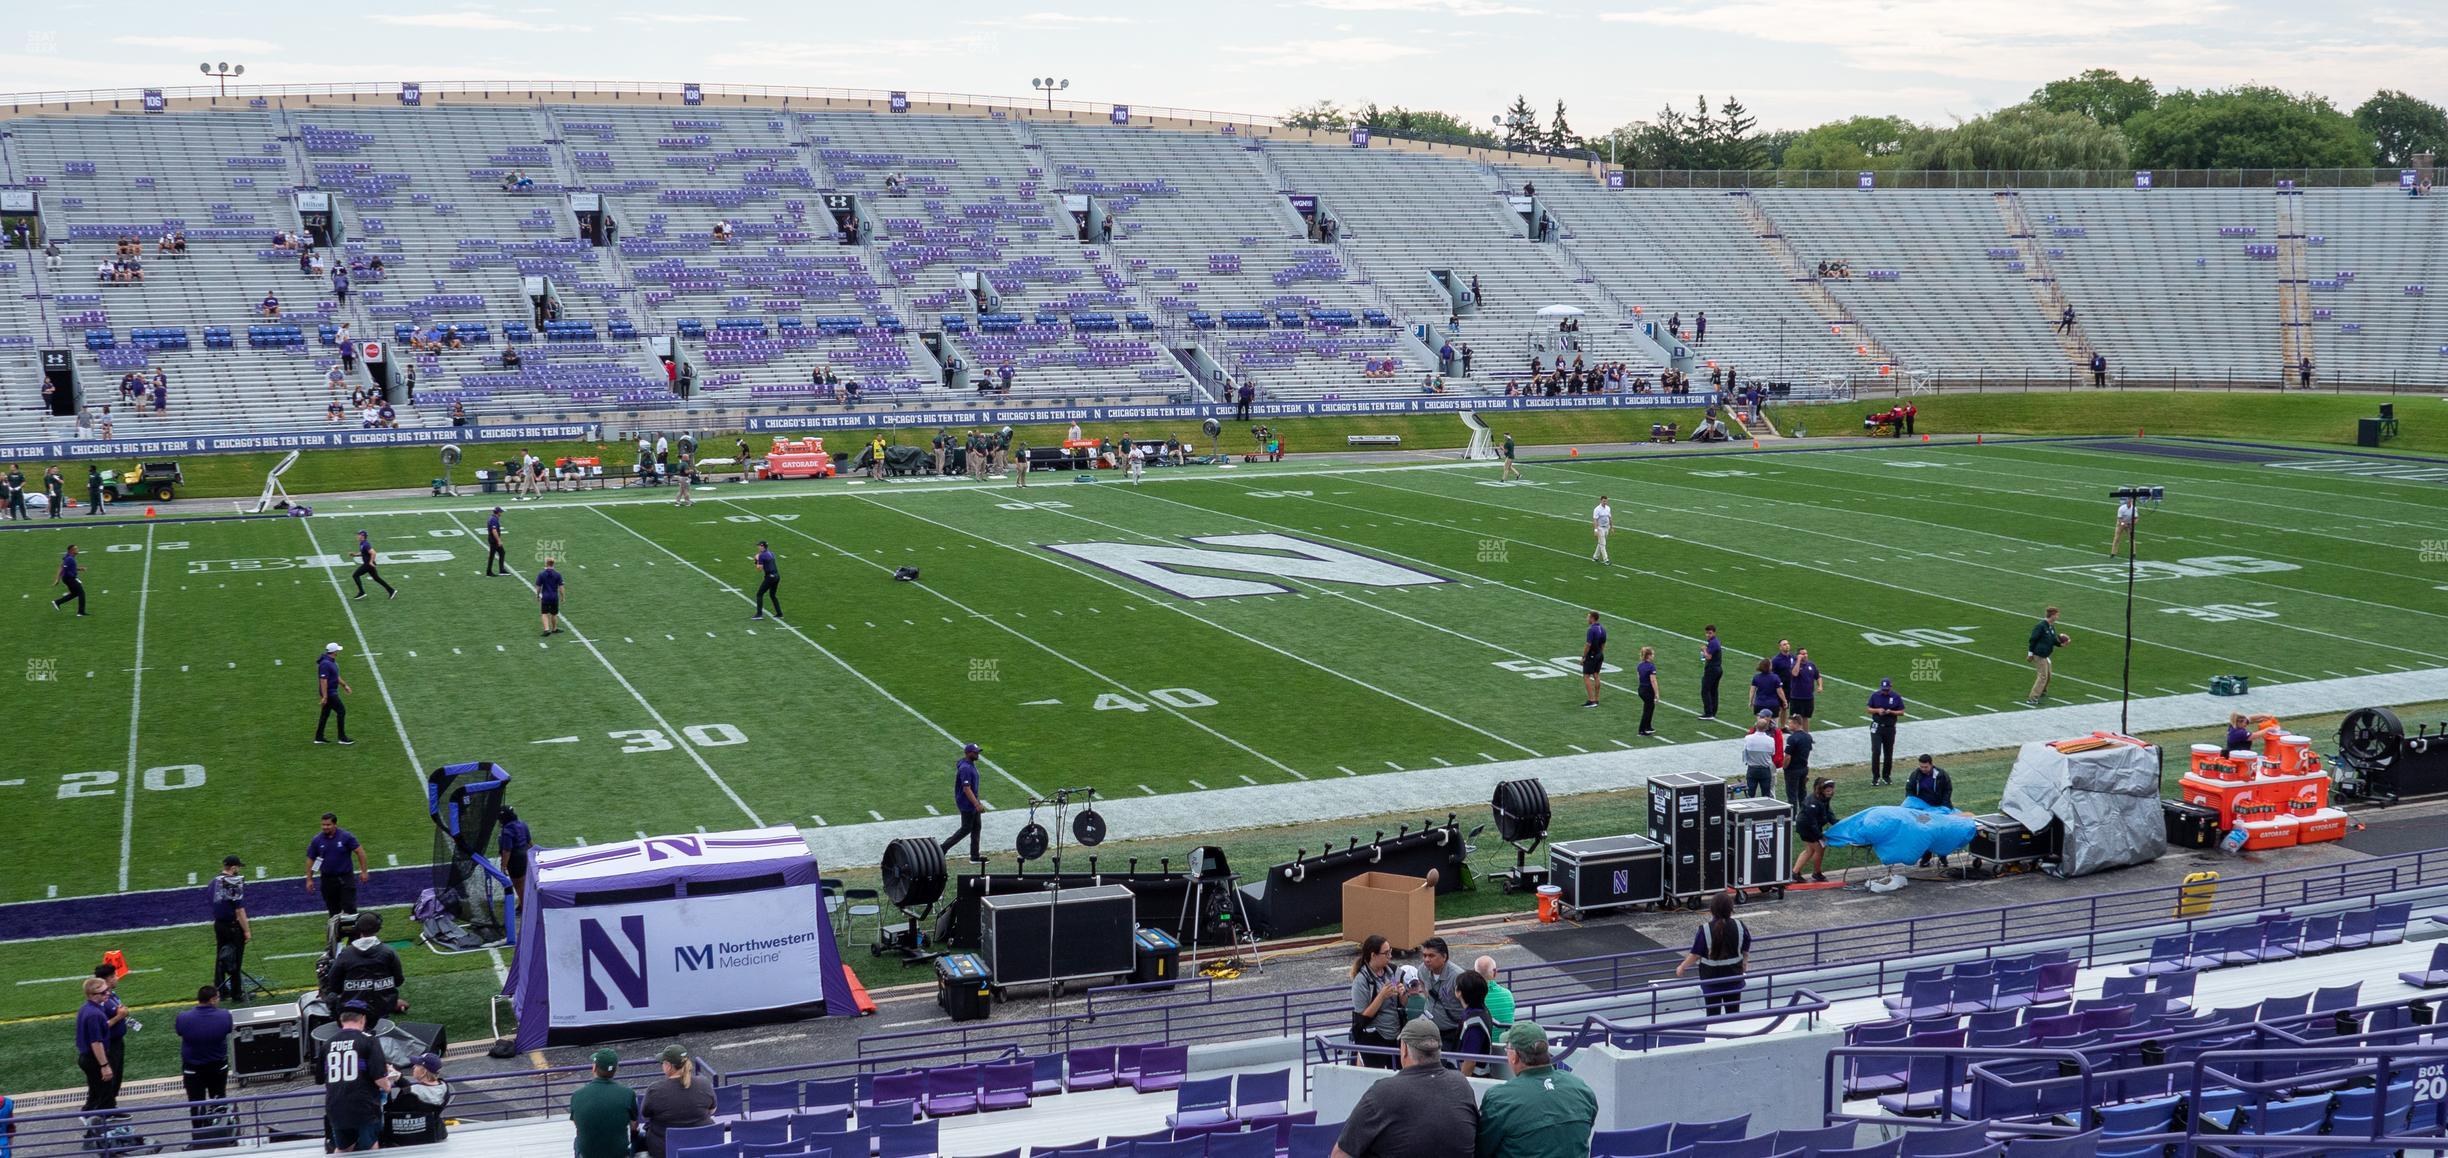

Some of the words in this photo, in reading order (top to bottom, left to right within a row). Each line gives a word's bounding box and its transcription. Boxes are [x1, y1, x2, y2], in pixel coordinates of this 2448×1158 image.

[146, 96, 161, 106] 106
[404, 89, 417, 99] 107
[1355, 133, 1366, 142] 111
[1611, 176, 1622, 186] 112
[1861, 177, 1872, 186] 113
[2137, 176, 2149, 186] 114
[750, 419, 757, 428] N
[807, 418, 820, 427] BIG
[822, 418, 837, 427] TEN
[839, 417, 860, 426] TEAM
[868, 416, 875, 425] N
[923, 415, 936, 423] BIG
[938, 414, 953, 423] TEN
[954, 414, 975, 422] TEAM
[983, 412, 989, 421] N
[1037, 412, 1049, 420] BIG
[1050, 411, 1065, 420] TEN
[1067, 410, 1086, 419] TEAM
[1095, 409, 1101, 418] N
[1146, 408, 1158, 417] BIG
[1160, 408, 1174, 417] TEN
[1176, 408, 1195, 416] TEAM
[1203, 407, 1209, 416] N
[1254, 406, 1265, 414] BIG
[1266, 405, 1280, 414] TEN
[1282, 405, 1301, 413] TEAM
[1308, 404, 1314, 413] N
[1358, 403, 1369, 411] BIG
[1371, 402, 1384, 411] TEN
[1386, 402, 1405, 411] TEAM
[1412, 401, 1418, 410] N
[1461, 401, 1472, 409] BIG
[1473, 400, 1486, 409] TEN
[1488, 400, 1506, 408] TEAM
[1513, 399, 1519, 407] N
[1561, 399, 1572, 407] BIG
[1573, 398, 1586, 406] TEN
[1588, 398, 1606, 406] TEAM
[1613, 397, 1619, 405] N
[1660, 397, 1671, 405] BIG
[1687, 396, 1706, 404] TEAM
[1712, 395, 1717, 403] N
[16, 447, 44, 457] TEAM
[53, 445, 62, 456] N
[123, 444, 138, 453] BIG
[141, 443, 159, 452] TEN
[162, 441, 188, 451] TEAM
[197, 440, 205, 449] N
[263, 437, 278, 447] BIG
[280, 437, 298, 446] TEN
[300, 436, 325, 445] TEAM
[334, 434, 341, 444] N
[397, 432, 412, 442] BIG
[413, 432, 431, 441] TEN
[433, 431, 456, 440] TEAM
[465, 429, 472, 439] N
[526, 428, 540, 437] BIG
[542, 427, 558, 437] TEN
[560, 426, 583, 436] TEAM
[1036, 532, 1460, 600] N
[2158, 604, 2280, 622] 30
[1860, 628, 1976, 648] 40
[1491, 656, 1623, 679] 50
[1093, 687, 1219, 712] 40
[608, 723, 749, 754] 30
[57, 764, 207, 799] 20
[2260, 830, 2290, 839] GATORADE
[2310, 823, 2339, 832] GATORADE
[644, 836, 702, 861] N
[1613, 869, 1628, 895] N
[719, 932, 815, 954] Northwestern
[580, 915, 649, 1012] N
[330, 1039, 355, 1052] PUGH
[327, 1050, 358, 1083] 80
[2418, 1064, 2445, 1078] BOX
[2413, 1076, 2447, 1102] 20
